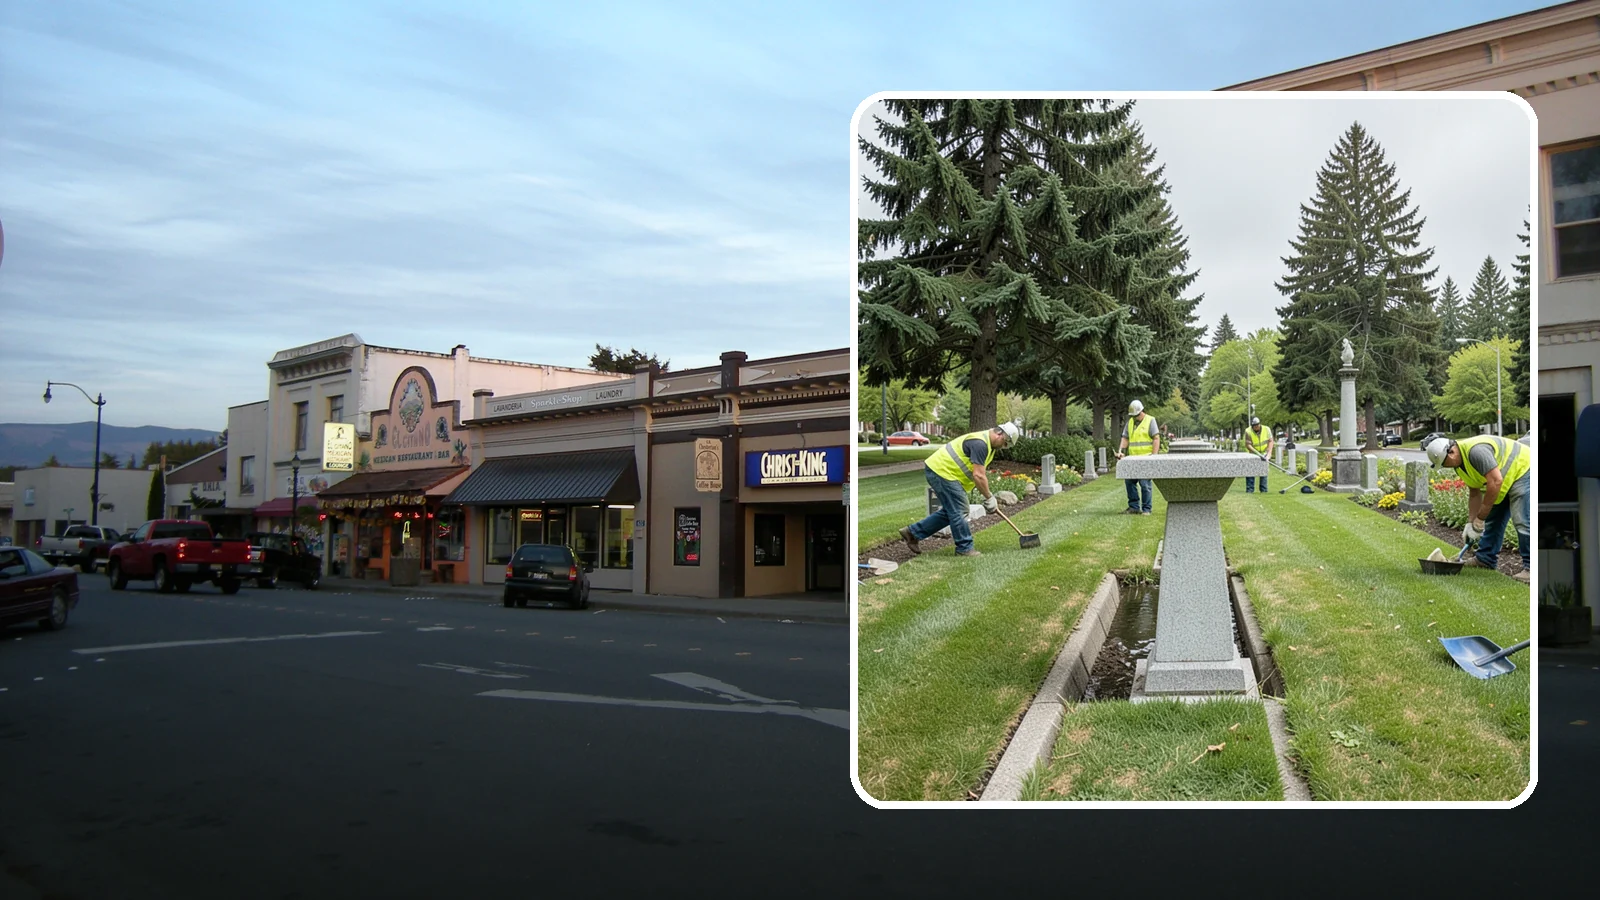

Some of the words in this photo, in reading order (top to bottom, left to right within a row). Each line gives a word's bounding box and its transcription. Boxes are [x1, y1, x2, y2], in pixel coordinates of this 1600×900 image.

[562, 394, 582, 405] Shop
[595, 389, 623, 400] LAUNDRY
[493, 401, 522, 412] LAVANDERIA
[373, 455, 396, 464] MEXICAN
[397, 451, 433, 462] RESTAURANT
[438, 450, 450, 459] BAR
[761, 452, 797, 478] CHRIST
[799, 450, 827, 476] KING
[709, 481, 722, 489] House
